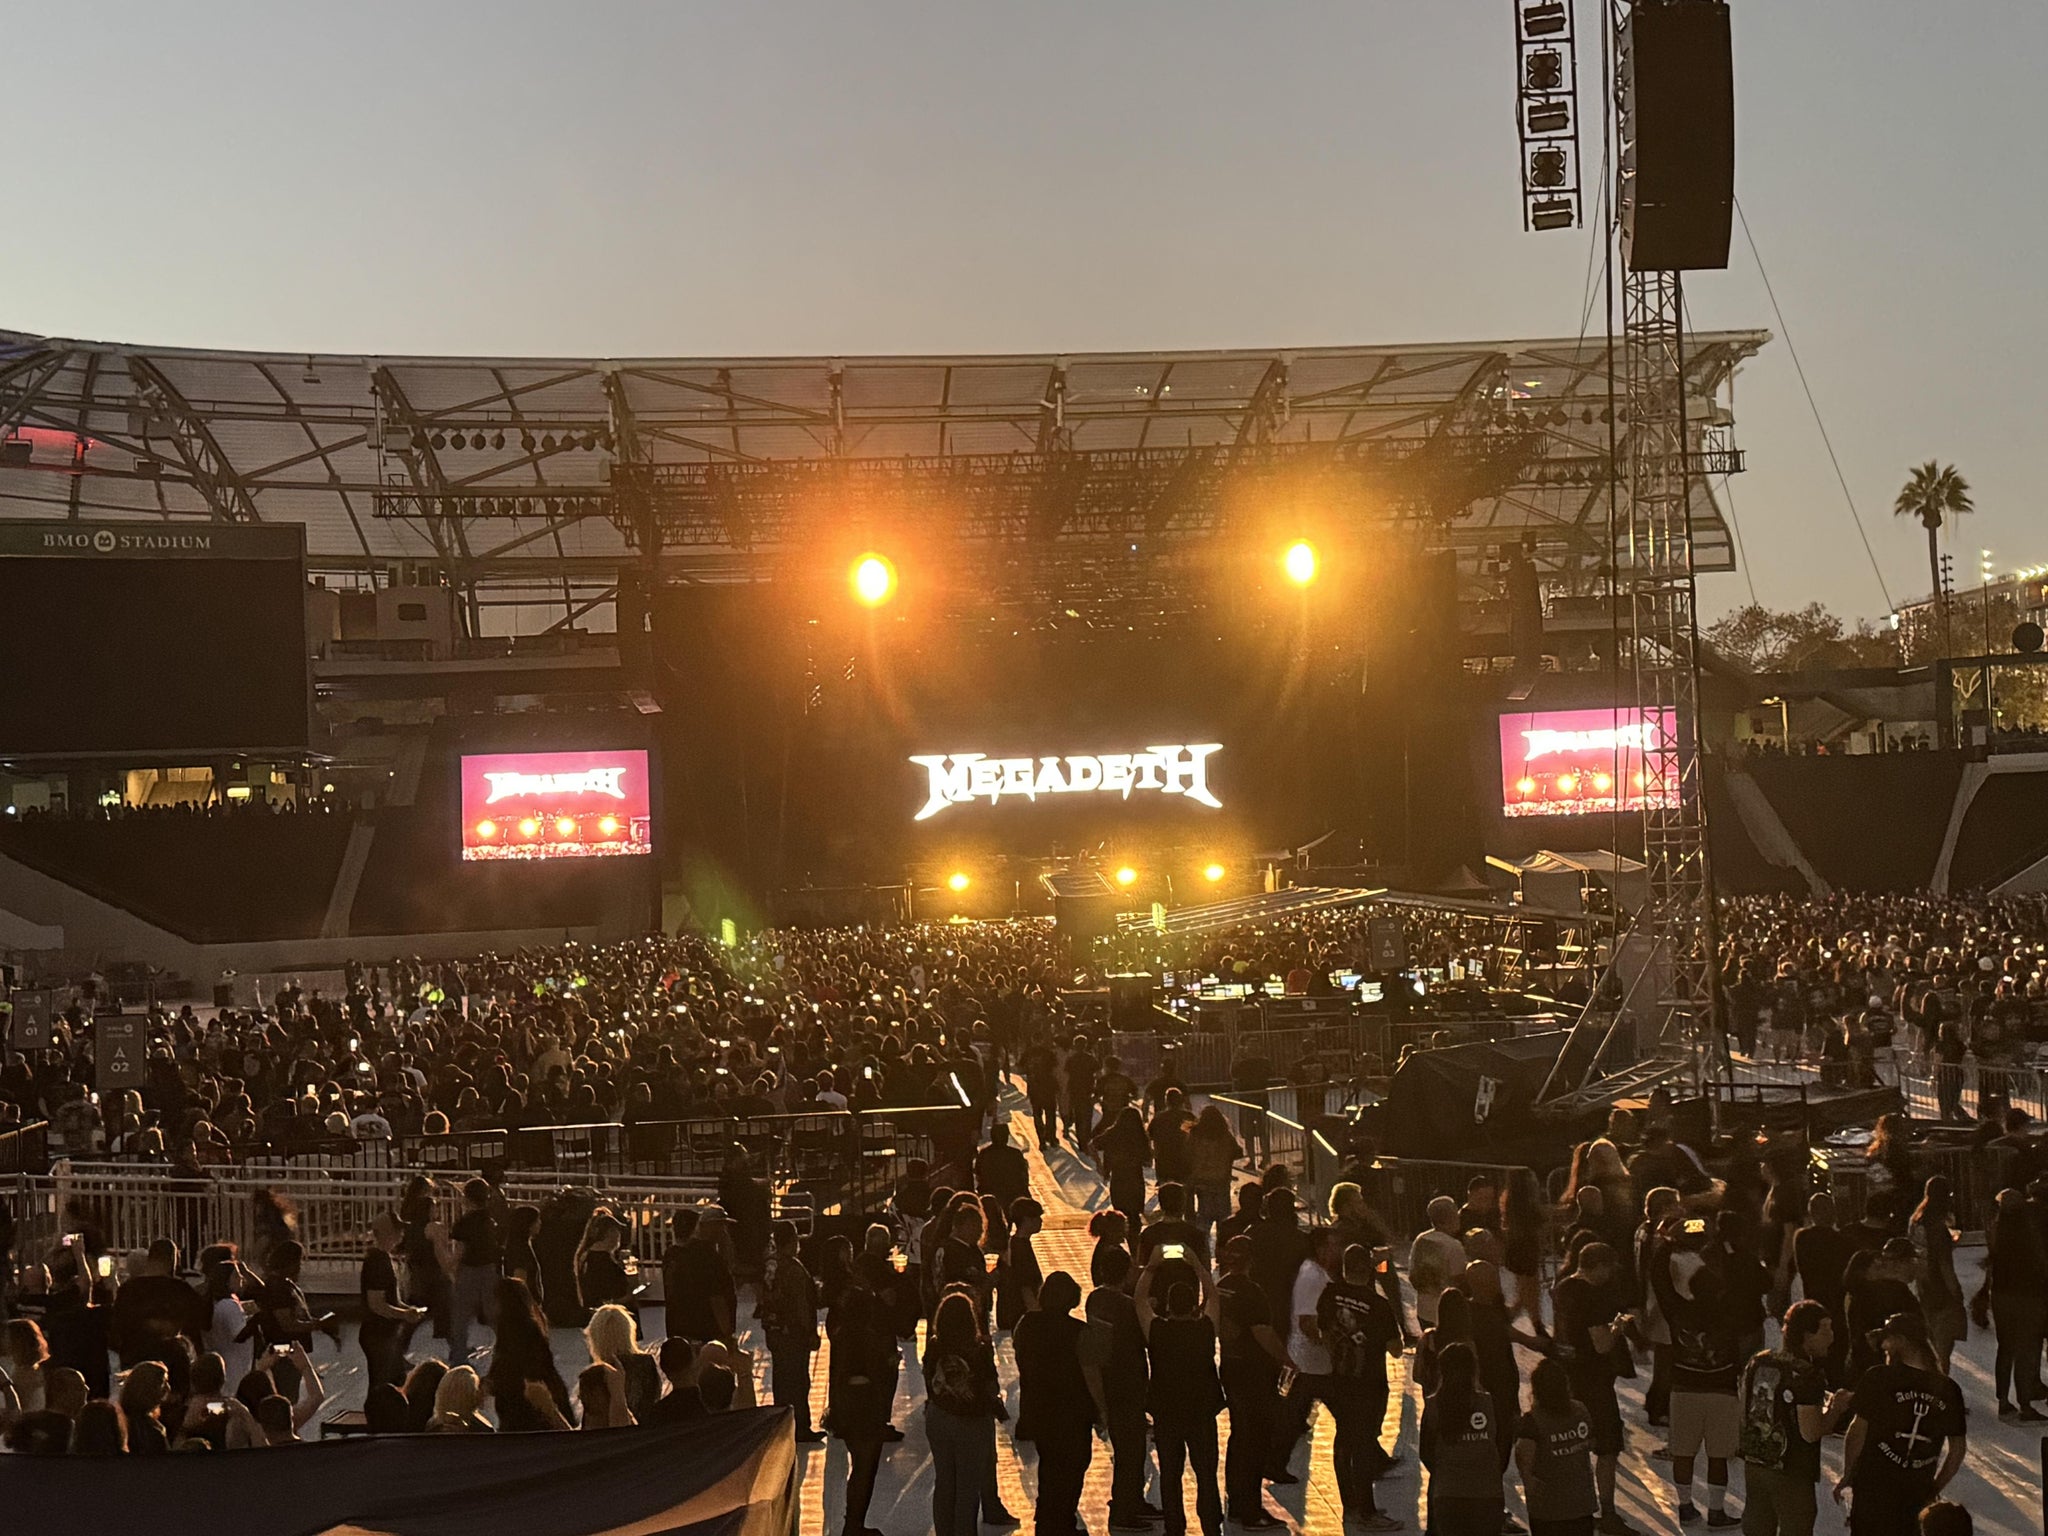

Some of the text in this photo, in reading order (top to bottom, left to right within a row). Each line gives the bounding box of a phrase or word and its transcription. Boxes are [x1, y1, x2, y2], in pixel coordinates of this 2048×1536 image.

[43, 534, 211, 550] BMO STADIUM
[907, 743, 1224, 822] MEGADETH
[27, 1014, 36, 1025] A
[114, 1046, 126, 1058] A
[110, 1061, 130, 1073] 02
